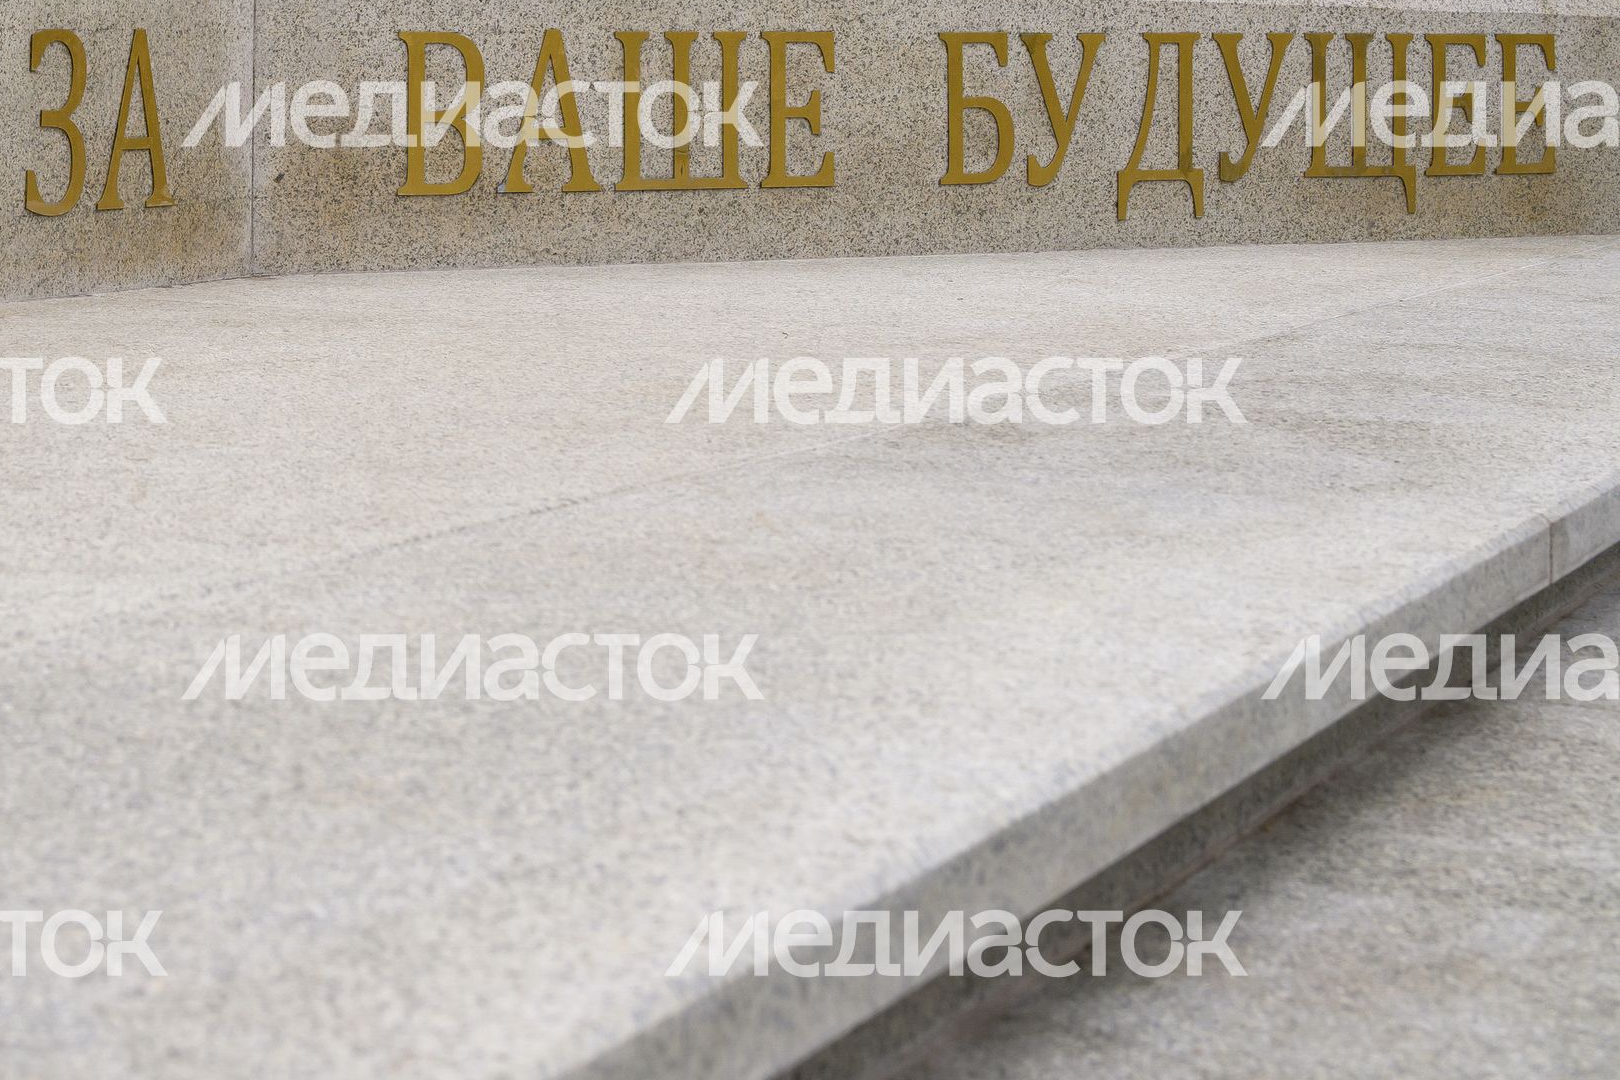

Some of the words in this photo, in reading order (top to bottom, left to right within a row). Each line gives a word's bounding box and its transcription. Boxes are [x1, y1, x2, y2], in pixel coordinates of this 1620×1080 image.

[24, 27, 176, 217] ЗА
[396, 28, 837, 197] ВАШЕ
[939, 30, 1558, 221] БУДУЩЕЕ
